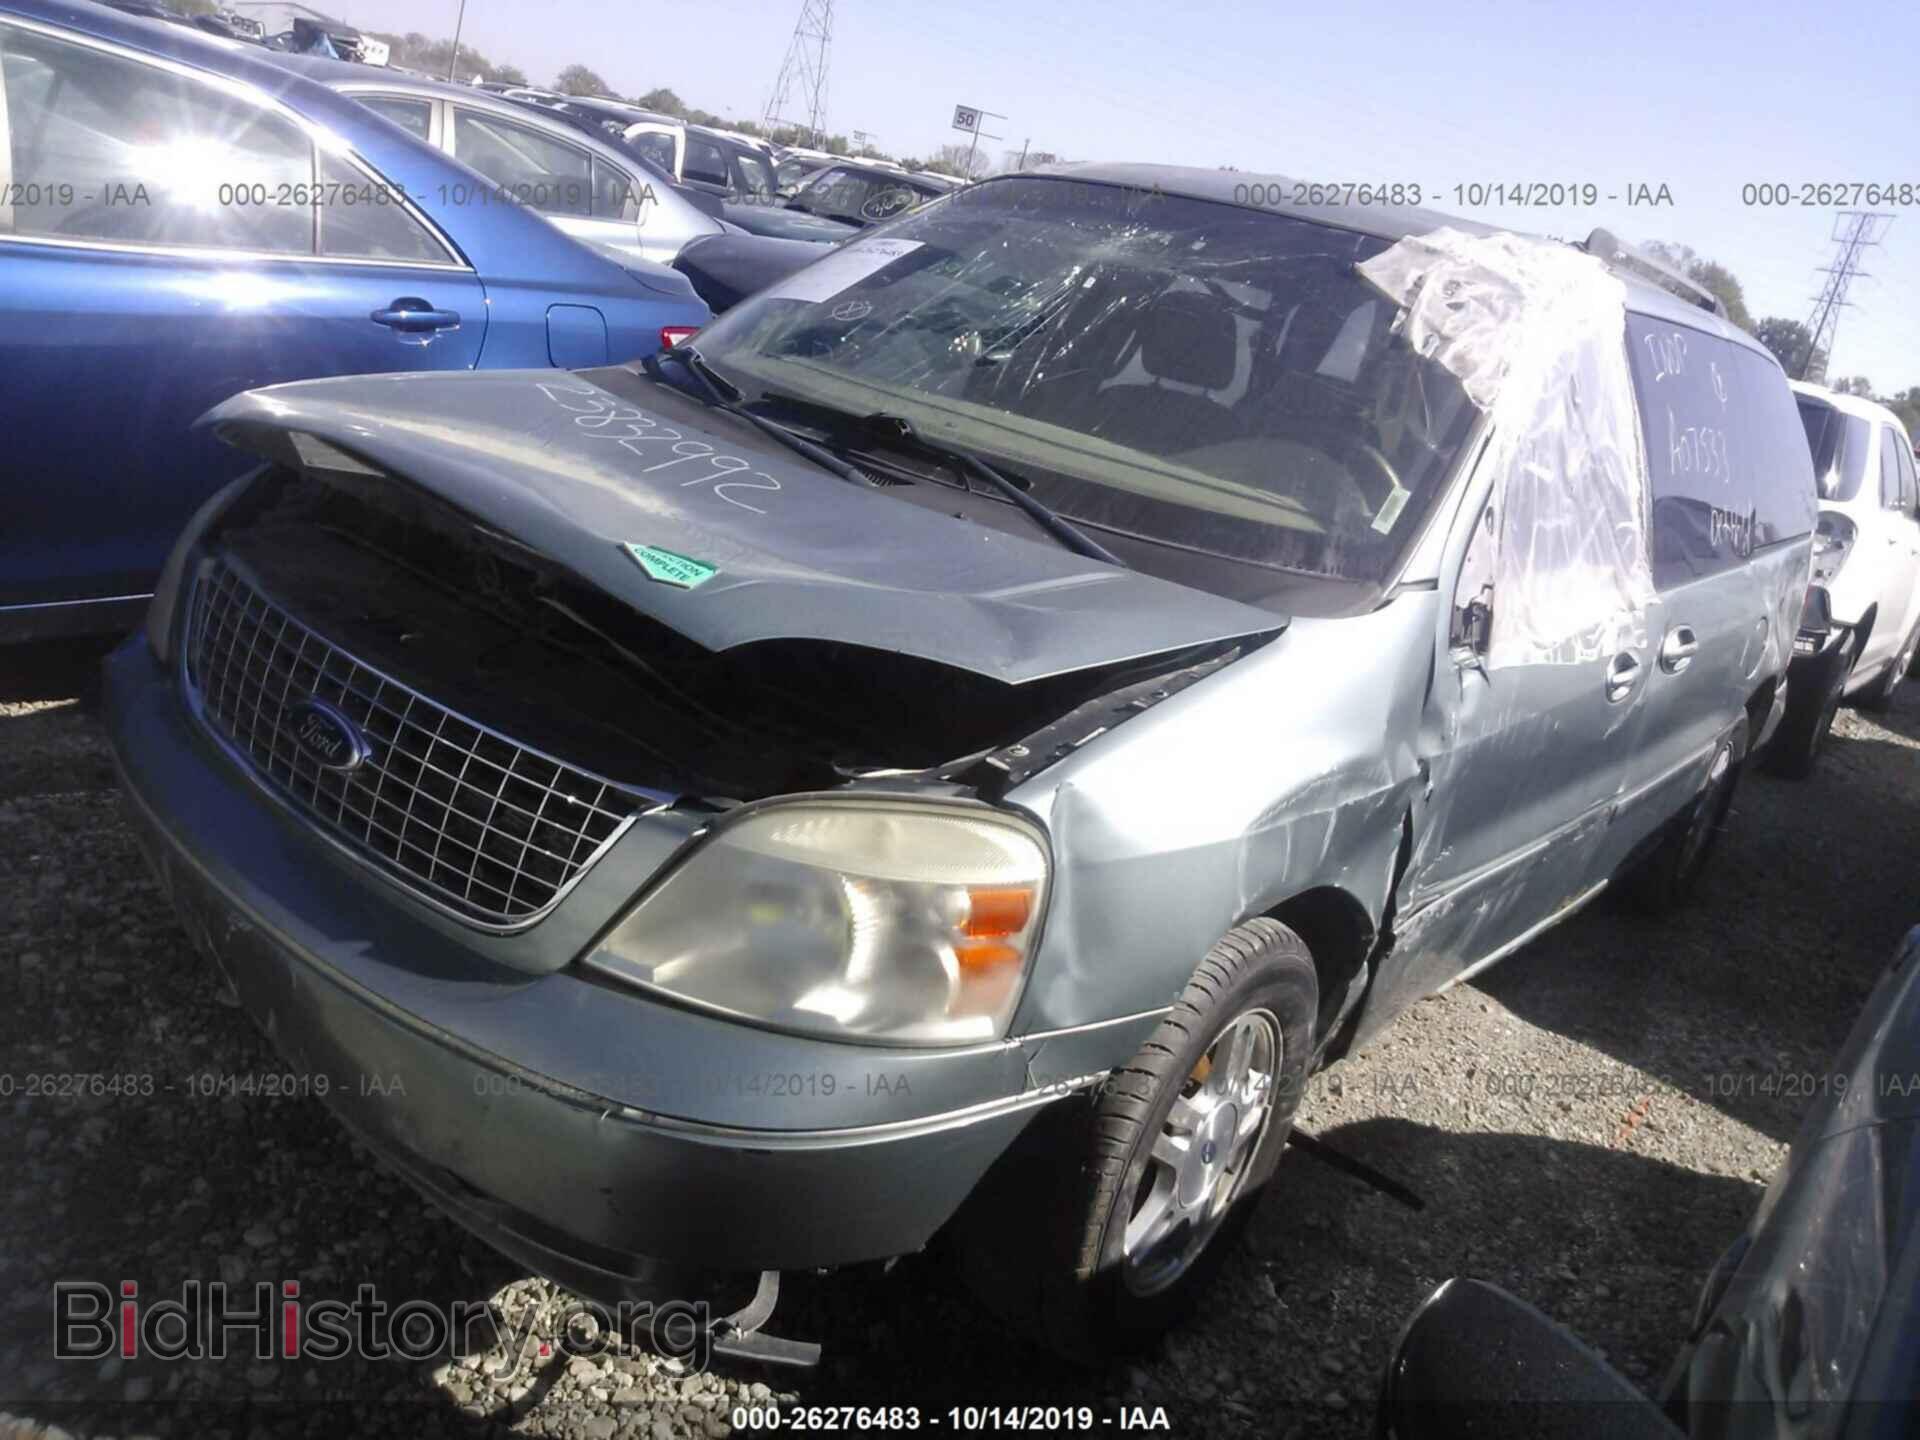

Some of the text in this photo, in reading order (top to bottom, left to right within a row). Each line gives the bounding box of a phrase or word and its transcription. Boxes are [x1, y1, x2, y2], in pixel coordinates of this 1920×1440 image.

[957, 112, 975, 127] 50
[634, 548, 692, 581] COMPLETE
[299, 714, 344, 757] Ford
